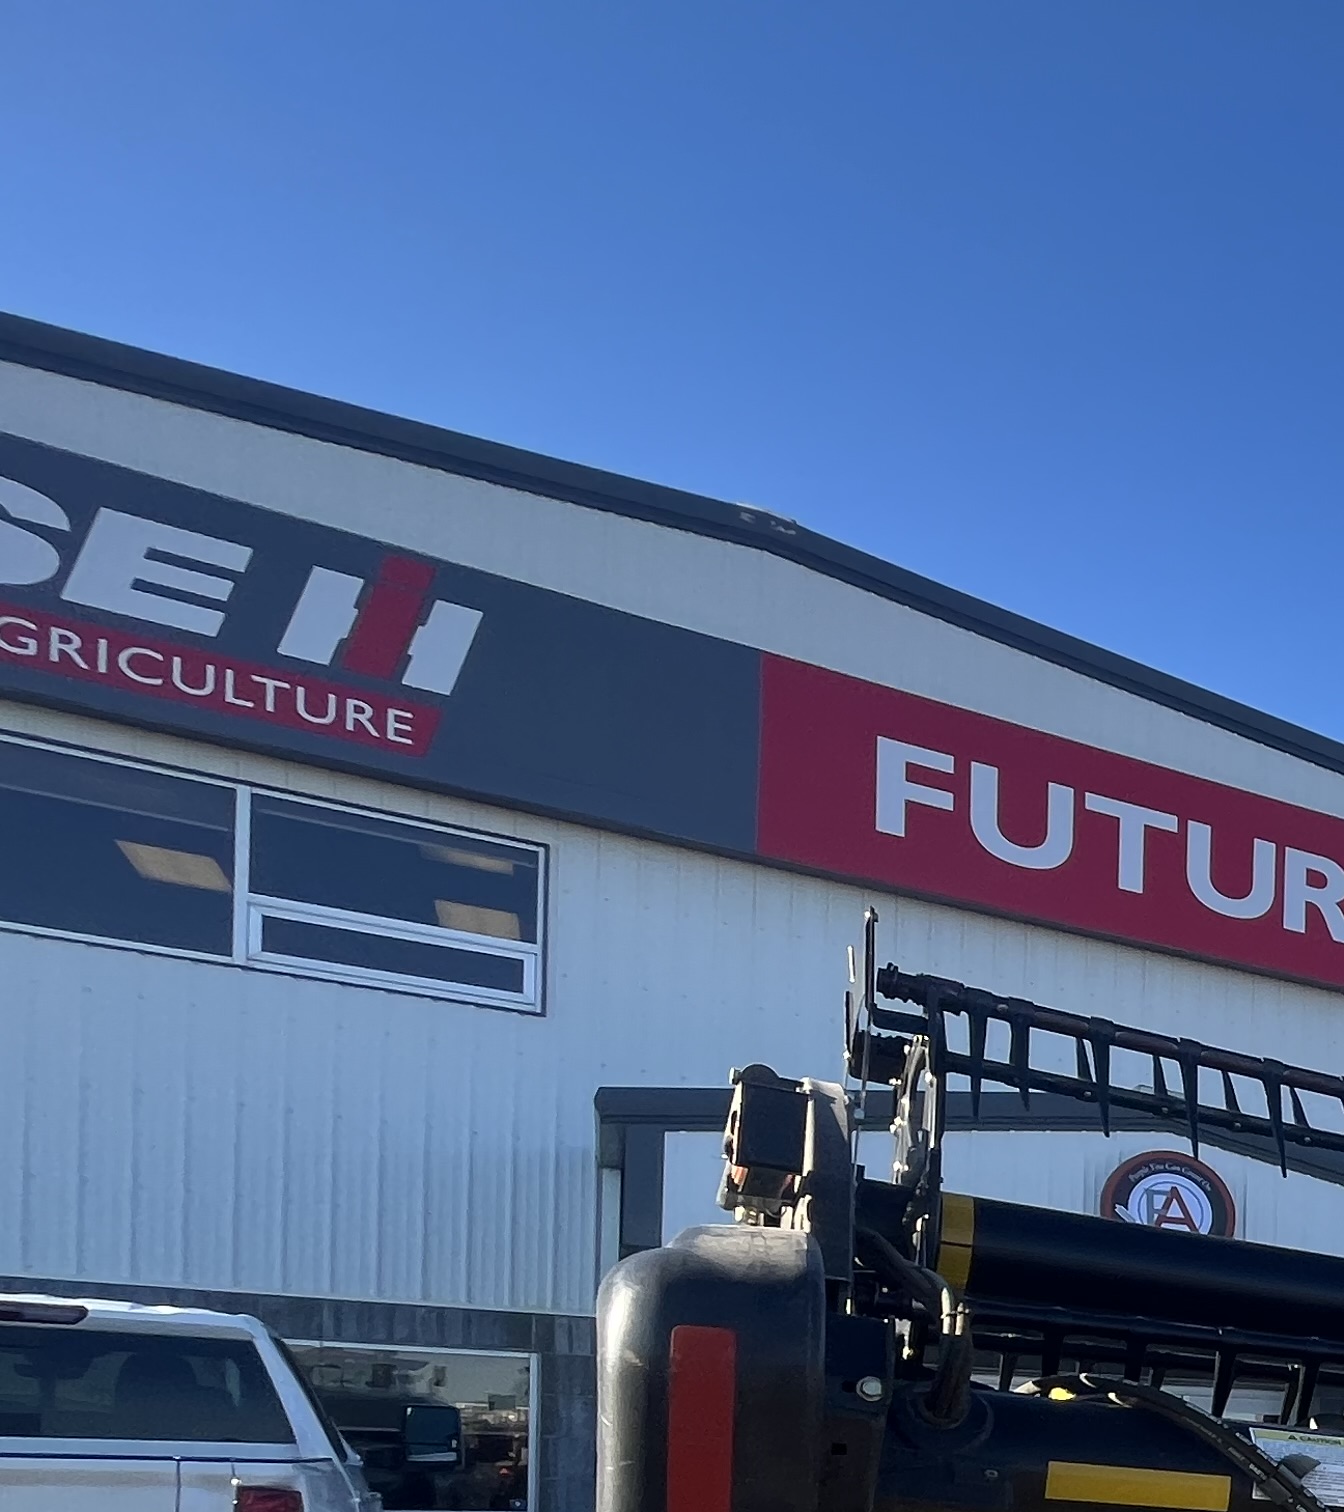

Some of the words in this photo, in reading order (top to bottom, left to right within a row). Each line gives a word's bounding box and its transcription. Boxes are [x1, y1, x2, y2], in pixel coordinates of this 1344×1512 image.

[1149, 1162, 1165, 1172] You
[1165, 1162, 1181, 1172] Can
[1299, 1436, 1342, 1446] CAUTION
